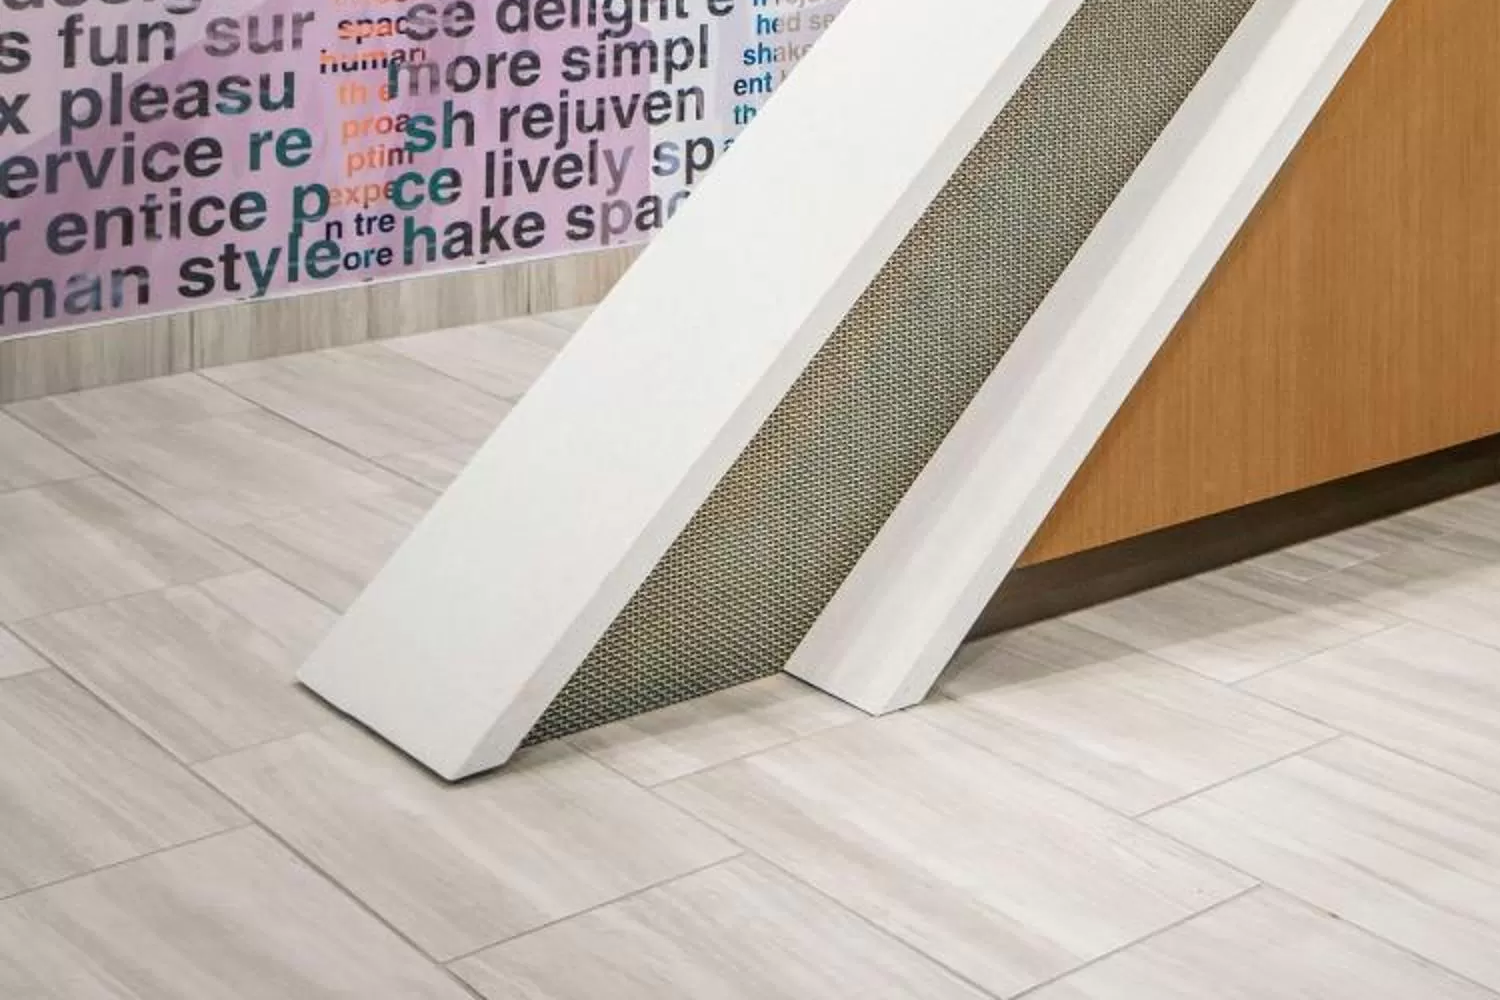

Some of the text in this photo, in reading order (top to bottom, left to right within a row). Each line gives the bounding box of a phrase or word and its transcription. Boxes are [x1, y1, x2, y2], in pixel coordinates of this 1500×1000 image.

[57, 12, 177, 70] fun
[202, 10, 315, 58] sur
[403, 0, 477, 42] se
[756, 12, 802, 37] hed
[319, 46, 427, 75] human
[387, 23, 710, 99] more simpl
[733, 70, 773, 96] ent
[59, 70, 296, 146] pleasu
[403, 83, 705, 154] sh rejuven
[0, 125, 313, 199] ervice re
[390, 132, 715, 212] ce lively sp
[45, 186, 268, 257] entice
[292, 182, 331, 239] p
[353, 211, 396, 238] tre
[402, 205, 547, 266] hake
[0, 227, 342, 327] man style
[342, 245, 394, 271] ore
